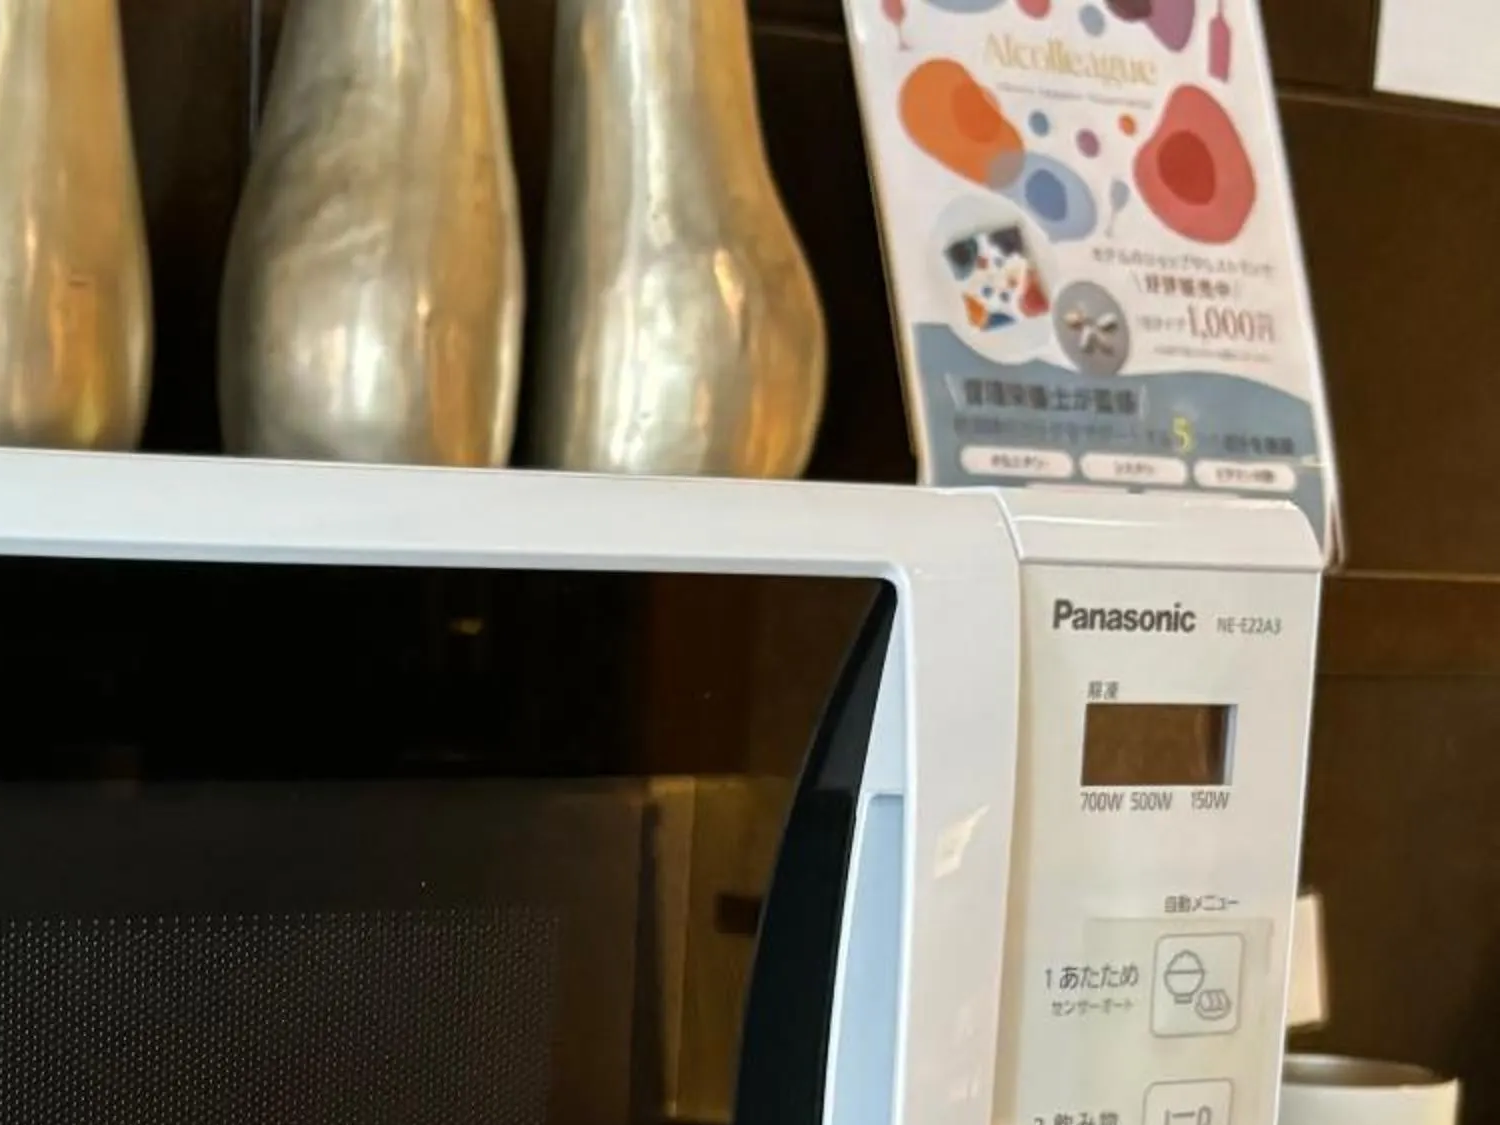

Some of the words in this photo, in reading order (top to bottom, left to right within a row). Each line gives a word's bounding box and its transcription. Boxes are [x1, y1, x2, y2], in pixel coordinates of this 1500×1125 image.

[1052, 599, 1196, 633] Panasonic
[1217, 616, 1282, 635] NE-E22A3
[1081, 792, 1125, 813] 700W
[1130, 791, 1173, 811] 500W
[1190, 791, 1231, 810] 150W
[1164, 895, 1240, 913] 自動メニュー
[1059, 964, 1140, 990] あたため
[1051, 999, 1133, 1017] センサーオート
